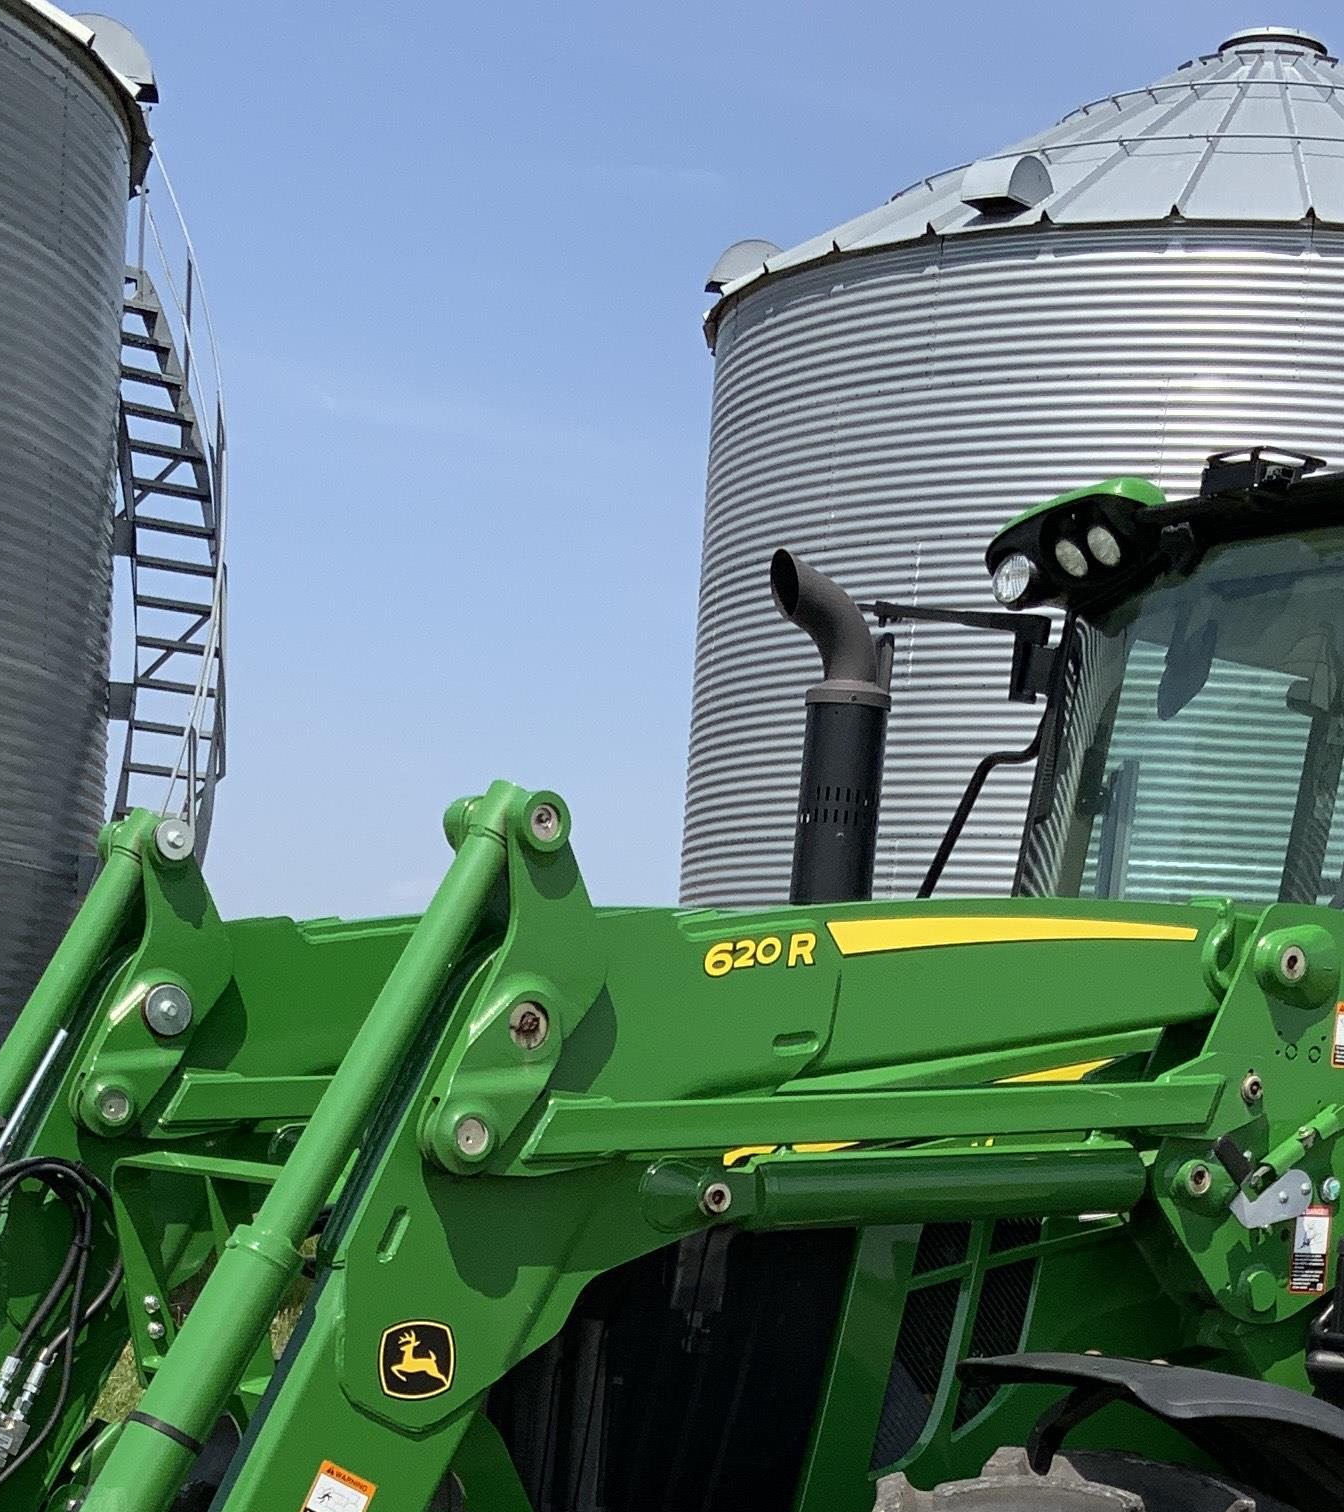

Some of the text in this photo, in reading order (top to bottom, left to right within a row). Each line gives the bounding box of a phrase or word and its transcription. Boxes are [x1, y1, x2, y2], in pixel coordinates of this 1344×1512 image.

[704, 931, 817, 977] 620 R
[334, 1471, 368, 1493] WARNING
